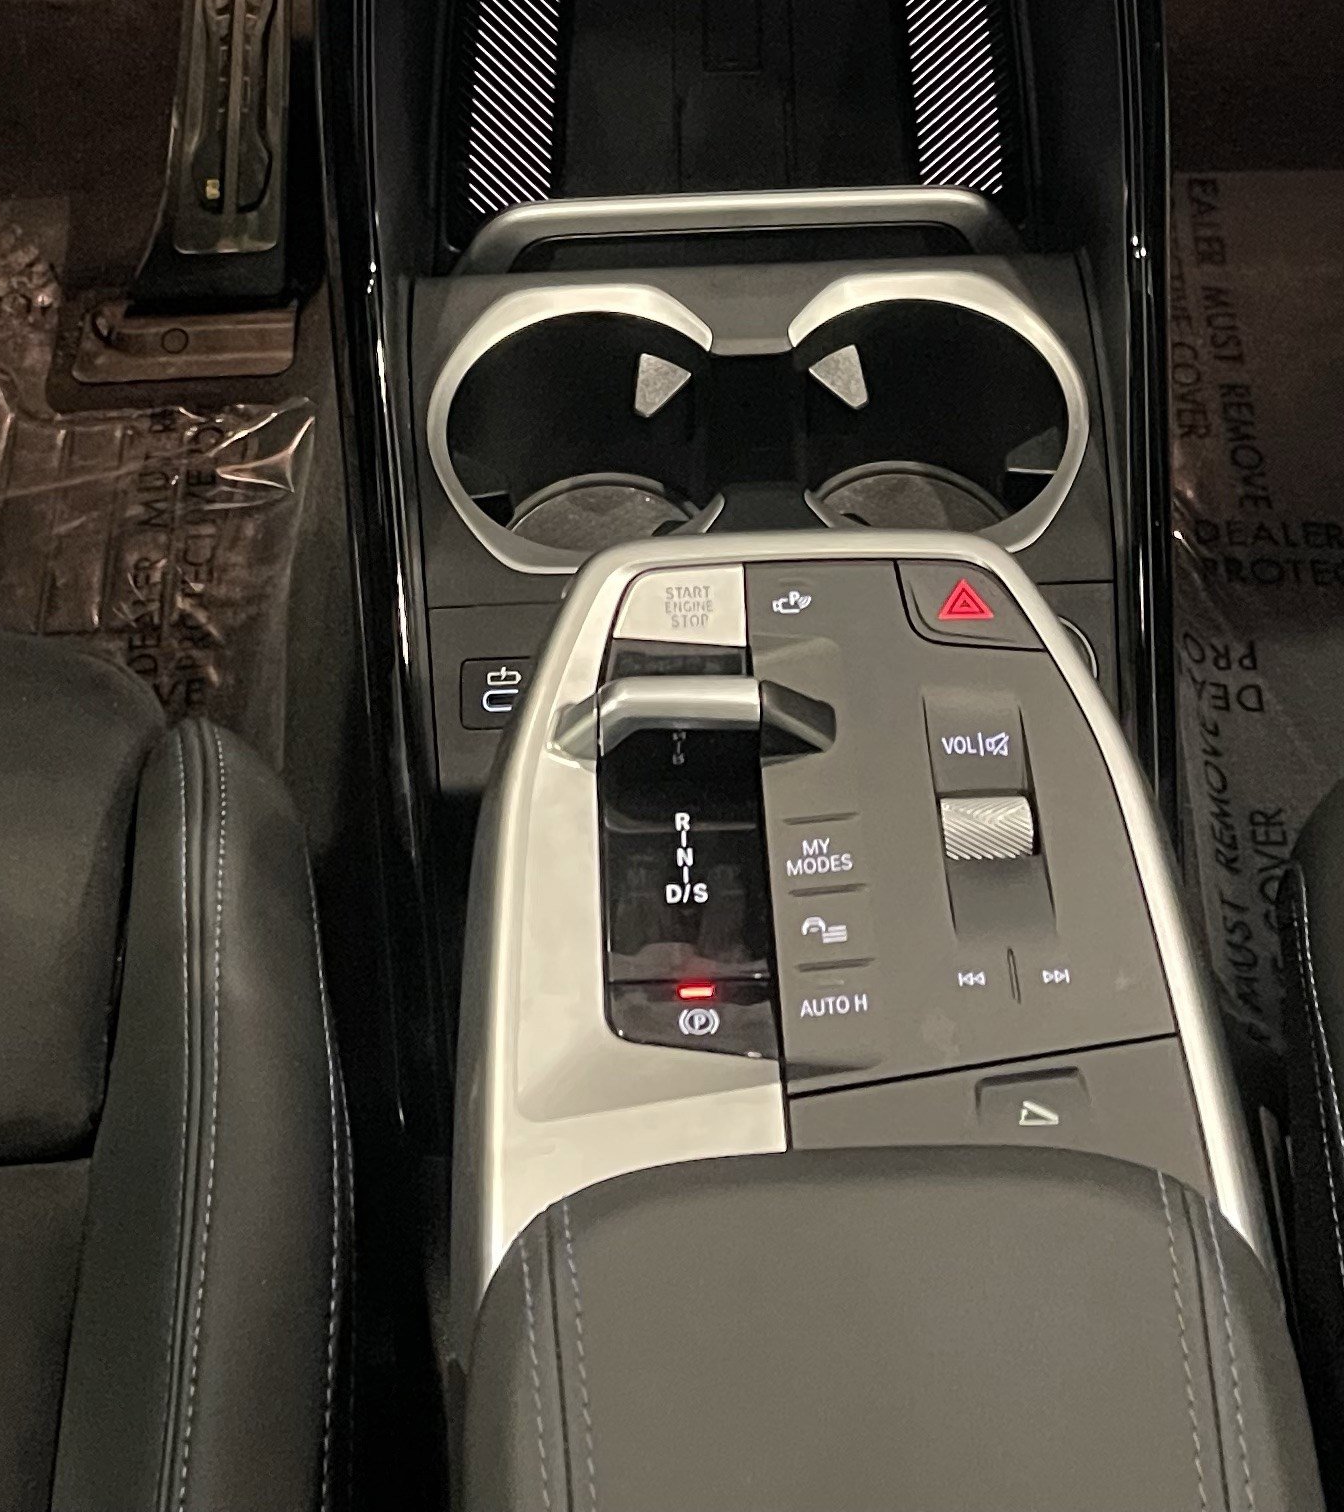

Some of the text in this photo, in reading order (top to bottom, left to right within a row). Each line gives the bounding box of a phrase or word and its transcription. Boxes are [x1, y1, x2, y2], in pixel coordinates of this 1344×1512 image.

[1201, 285, 1246, 366] MUST
[1217, 382, 1274, 511] REMOVE
[665, 585, 711, 600] START
[665, 599, 714, 614] ENGINE
[671, 613, 709, 628] STOP
[674, 812, 691, 832] R
[801, 837, 830, 856] MY
[676, 847, 694, 867] N
[786, 853, 853, 876] MODES
[665, 883, 709, 904] D/S
[800, 994, 868, 1017] AUTO H
